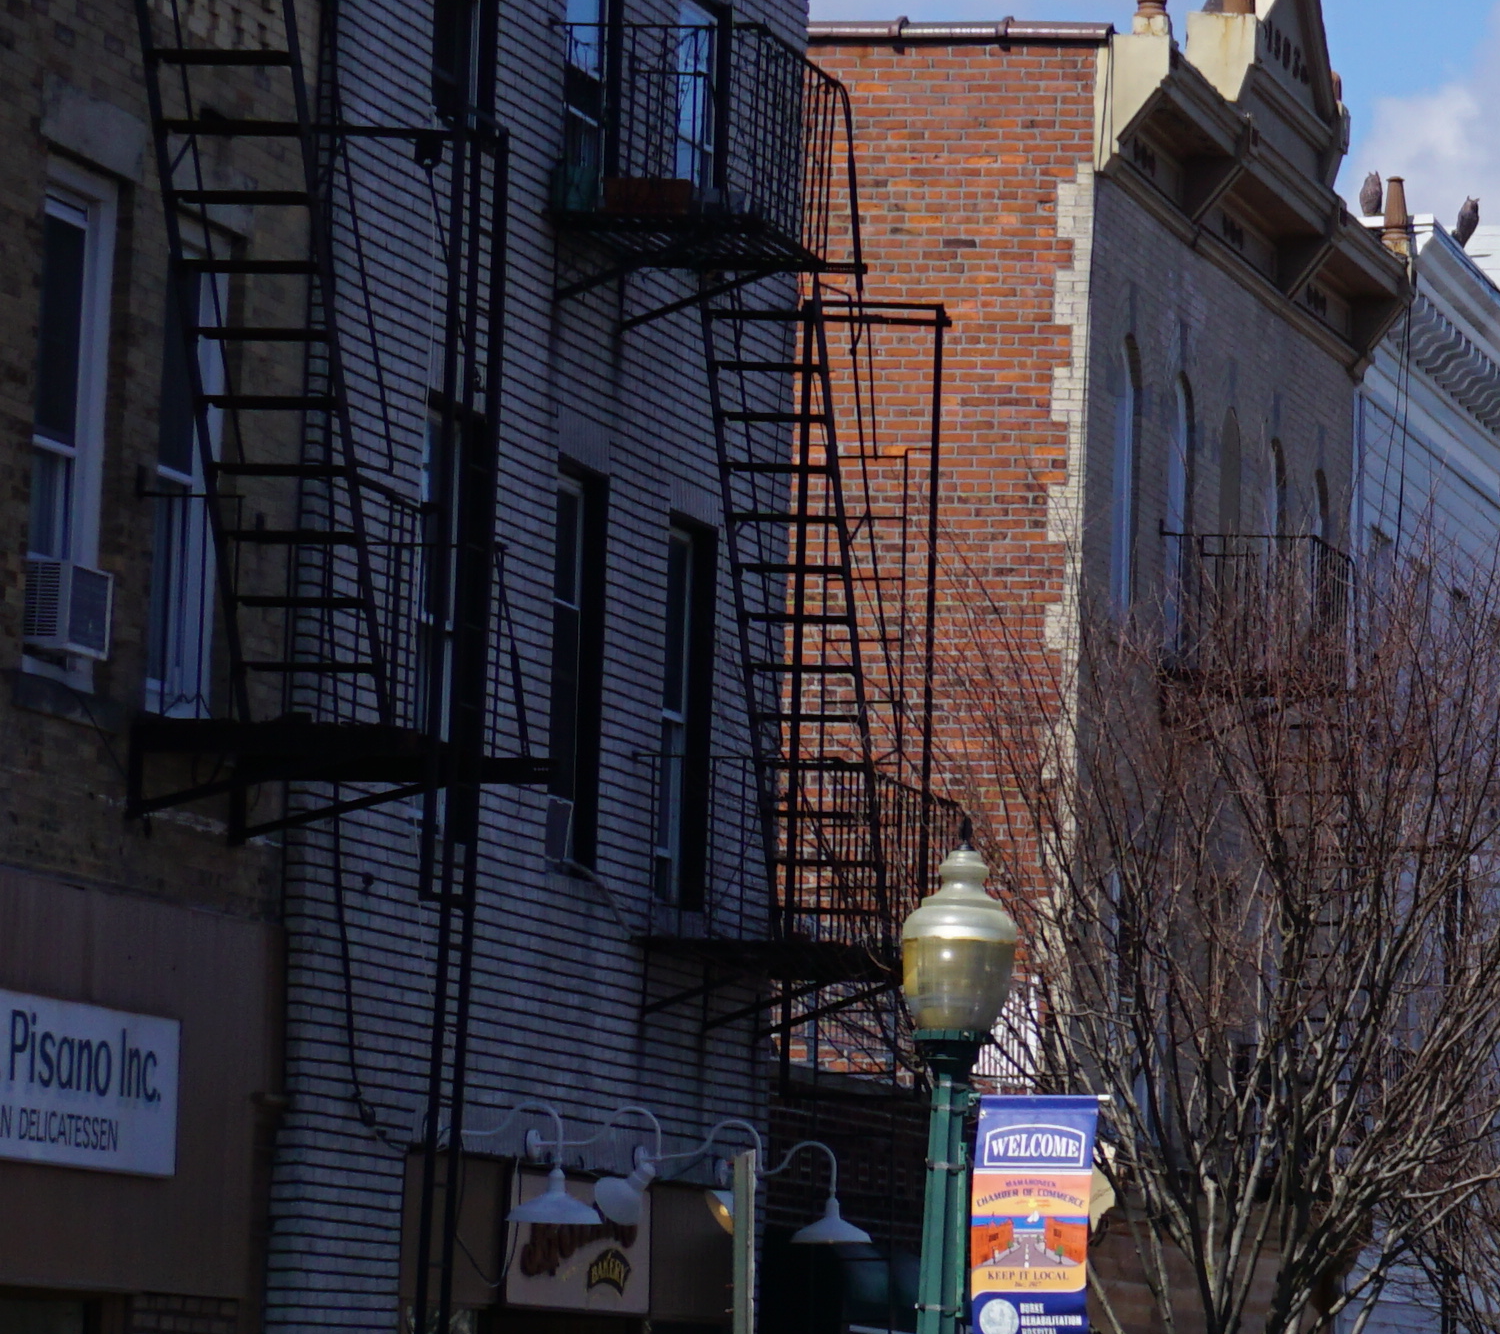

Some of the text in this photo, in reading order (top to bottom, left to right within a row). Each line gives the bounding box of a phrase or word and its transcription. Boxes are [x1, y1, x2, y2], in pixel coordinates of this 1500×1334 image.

[10, 1008, 161, 1102] Pisano Inc.
[18, 1107, 119, 1152] DELICATESSEN
[991, 1132, 1079, 1158] WELCOME
[976, 1188, 1085, 1209] CHAMBER OF COMMERCE
[591, 1253, 626, 1287] BAKERY
[987, 1271, 1069, 1280] KEEP IT LOCAL
[1020, 1315, 1082, 1327] REHABILITATION
